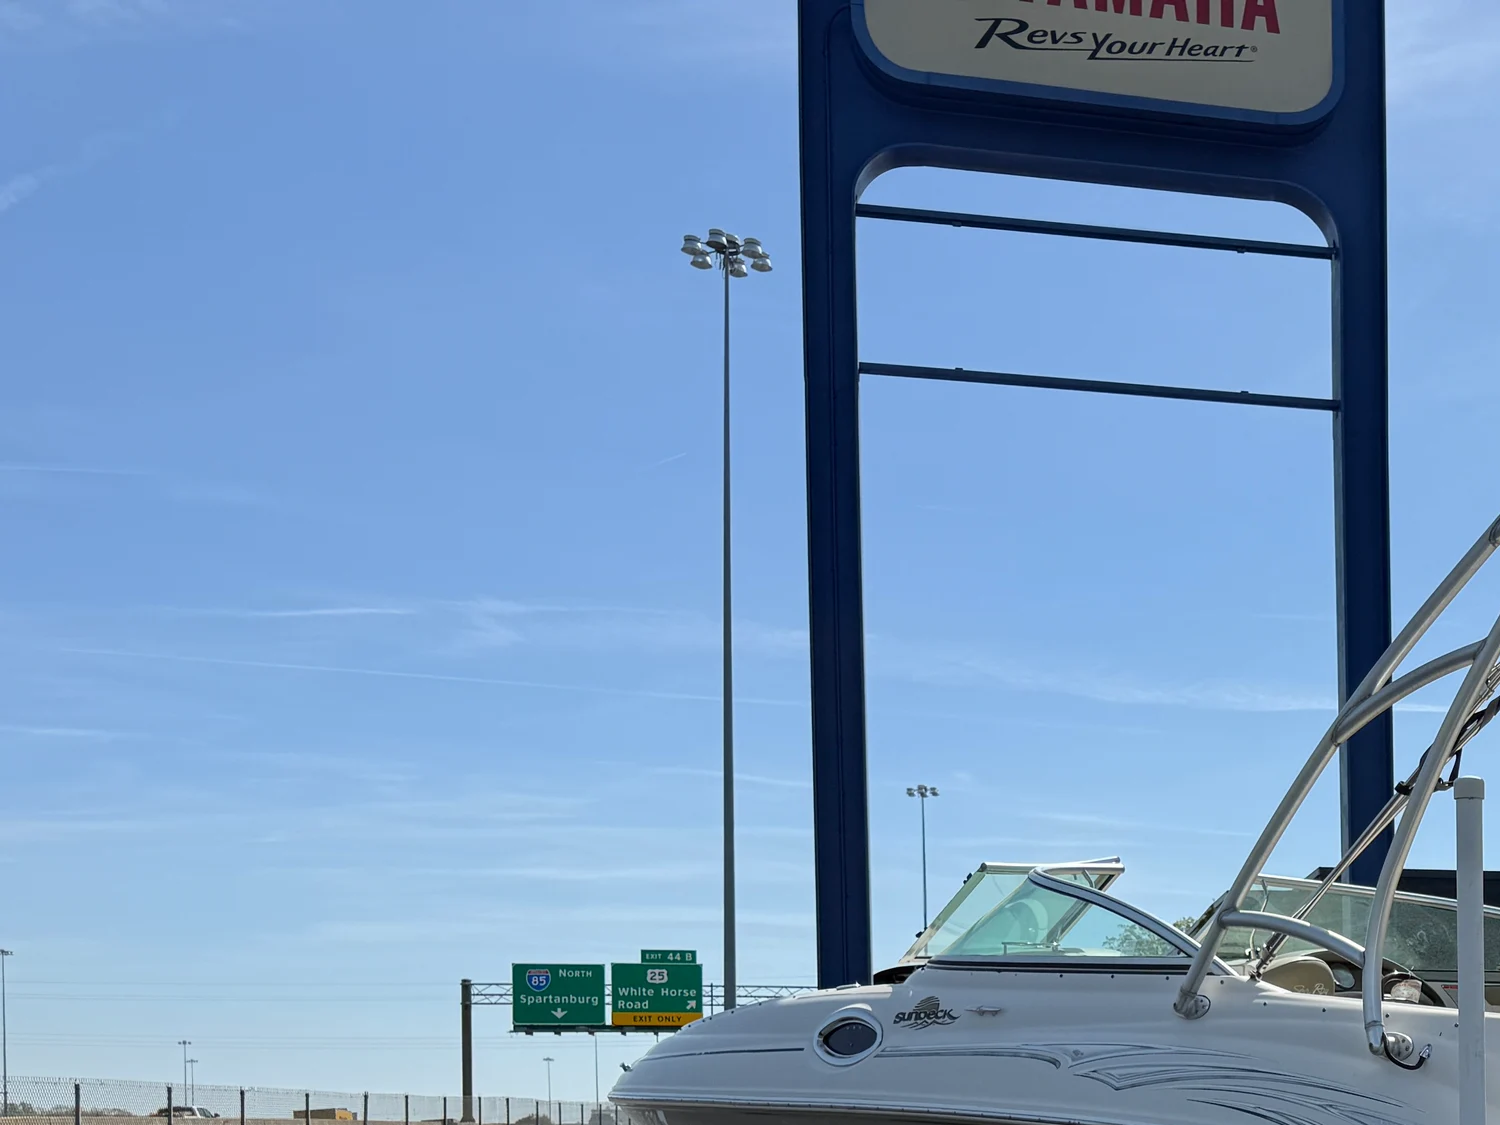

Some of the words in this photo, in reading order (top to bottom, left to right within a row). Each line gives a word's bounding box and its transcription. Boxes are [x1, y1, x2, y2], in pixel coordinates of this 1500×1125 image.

[974, 17, 1088, 51] Revs
[1087, 32, 1166, 60] Your
[667, 952, 681, 961] 44
[685, 952, 692, 961] B
[558, 968, 593, 978] NORTH
[649, 971, 665, 981] 25
[531, 975, 547, 986] 85
[618, 987, 654, 997] White
[661, 987, 697, 997] Horse
[519, 994, 599, 1006] Spartanburg
[618, 1000, 649, 1009] Road
[633, 1015, 652, 1023] EXIT
[657, 1015, 682, 1023] ONLY
